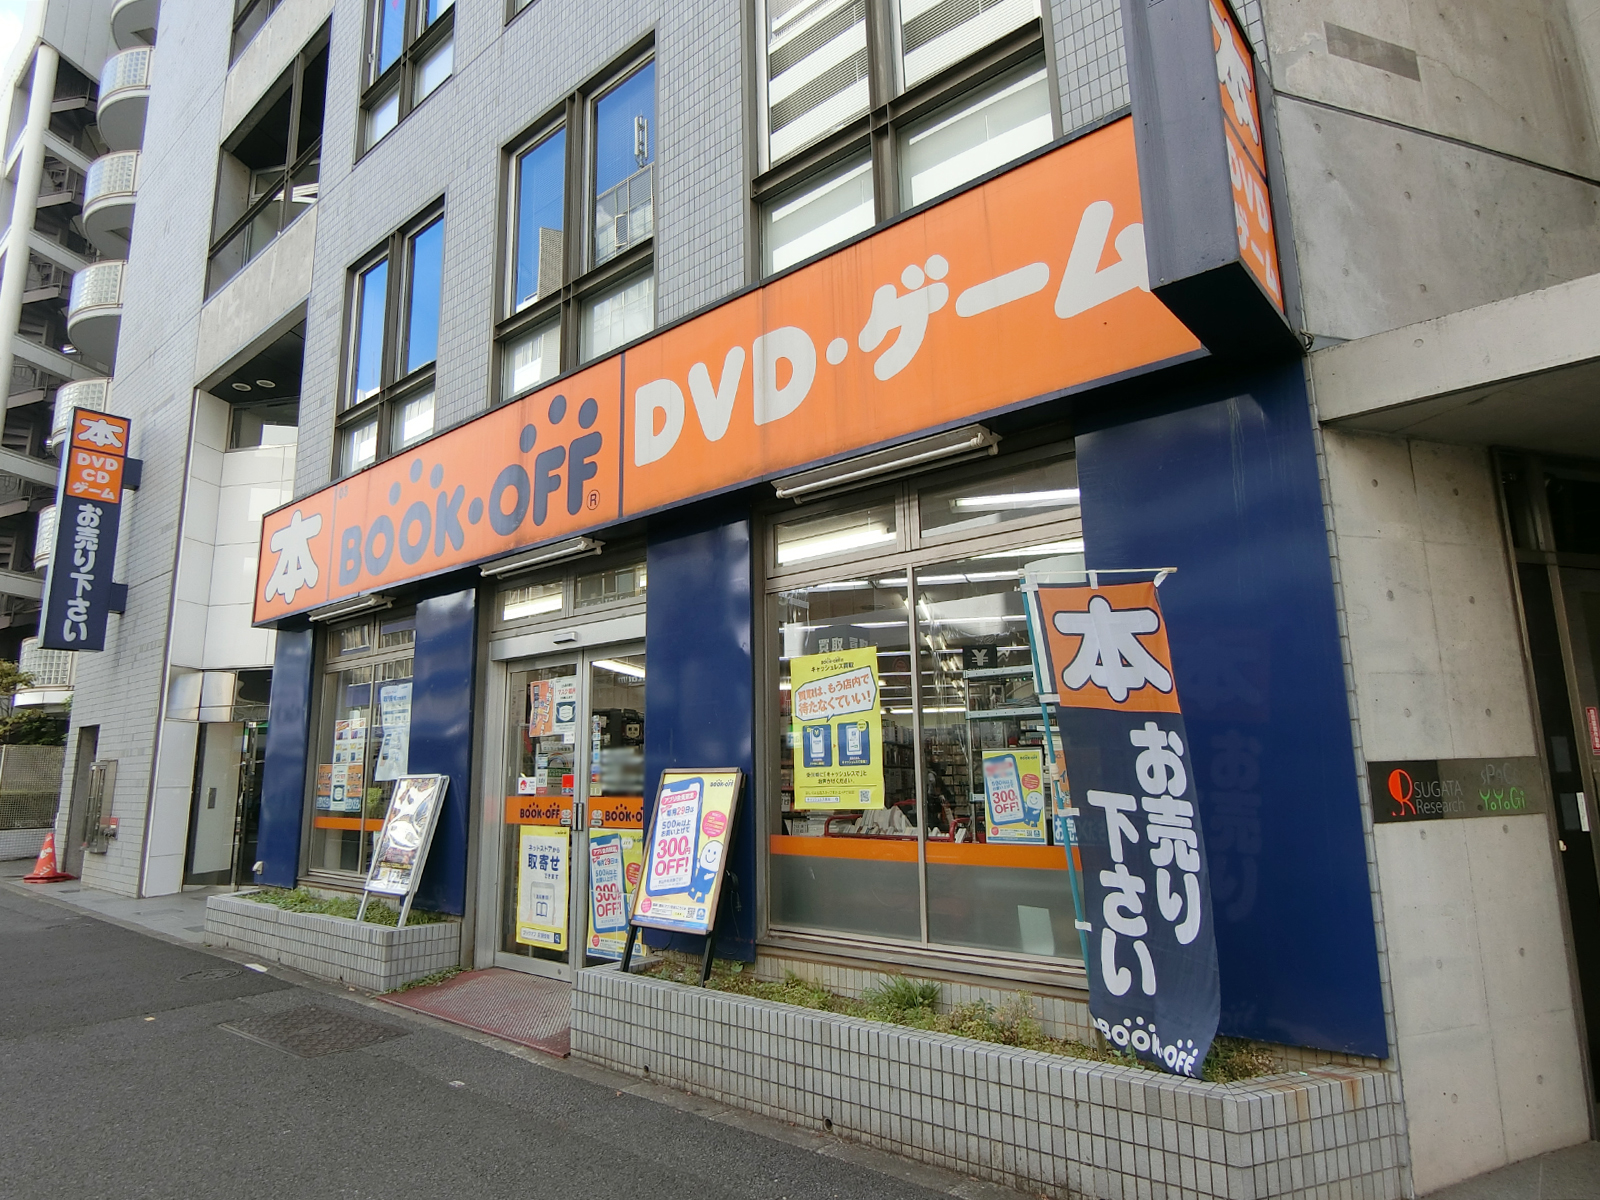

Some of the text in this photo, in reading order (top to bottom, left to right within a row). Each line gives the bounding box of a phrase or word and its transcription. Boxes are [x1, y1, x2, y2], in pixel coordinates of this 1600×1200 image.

[77, 418, 124, 448] 本
[76, 453, 119, 472] DVD
[81, 469, 111, 485] CD
[71, 481, 116, 502] ゲーム
[265, 509, 324, 605] 本
[62, 502, 103, 643] お売り下さい
[818, 636, 844, 654] 買取
[1053, 595, 1173, 702] 本
[811, 661, 854, 673] キャッシュレス買取
[797, 673, 870, 702] 買取は、もう店内で
[1413, 779, 1464, 799] SUGATA
[994, 801, 1020, 814] OFF!
[1415, 795, 1466, 815] Research
[1130, 721, 1201, 945] お売り
[528, 844, 560, 854] ネットストアから
[527, 853, 560, 872] 取寄せ
[654, 856, 689, 877] OFF!
[1086, 789, 1157, 997] 下さい
